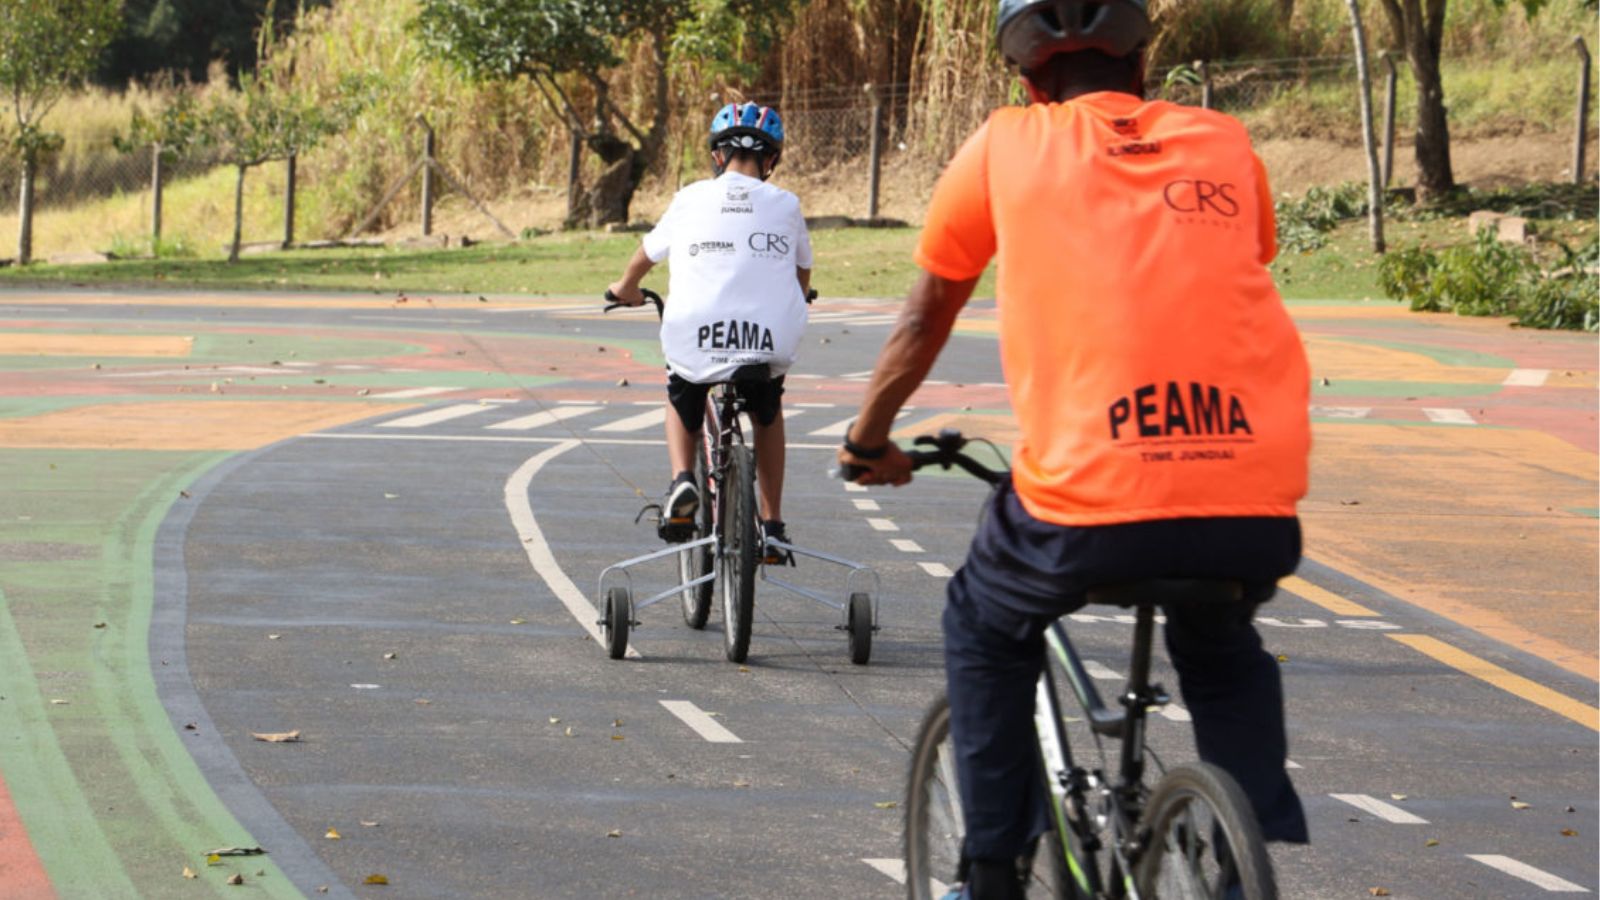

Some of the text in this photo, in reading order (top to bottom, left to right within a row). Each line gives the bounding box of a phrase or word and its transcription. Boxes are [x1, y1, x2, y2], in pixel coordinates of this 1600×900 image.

[1163, 179, 1240, 218] CRS
[748, 232, 790, 255] CRS
[697, 319, 775, 351] PEAMA
[1109, 381, 1253, 440] PEAMA
